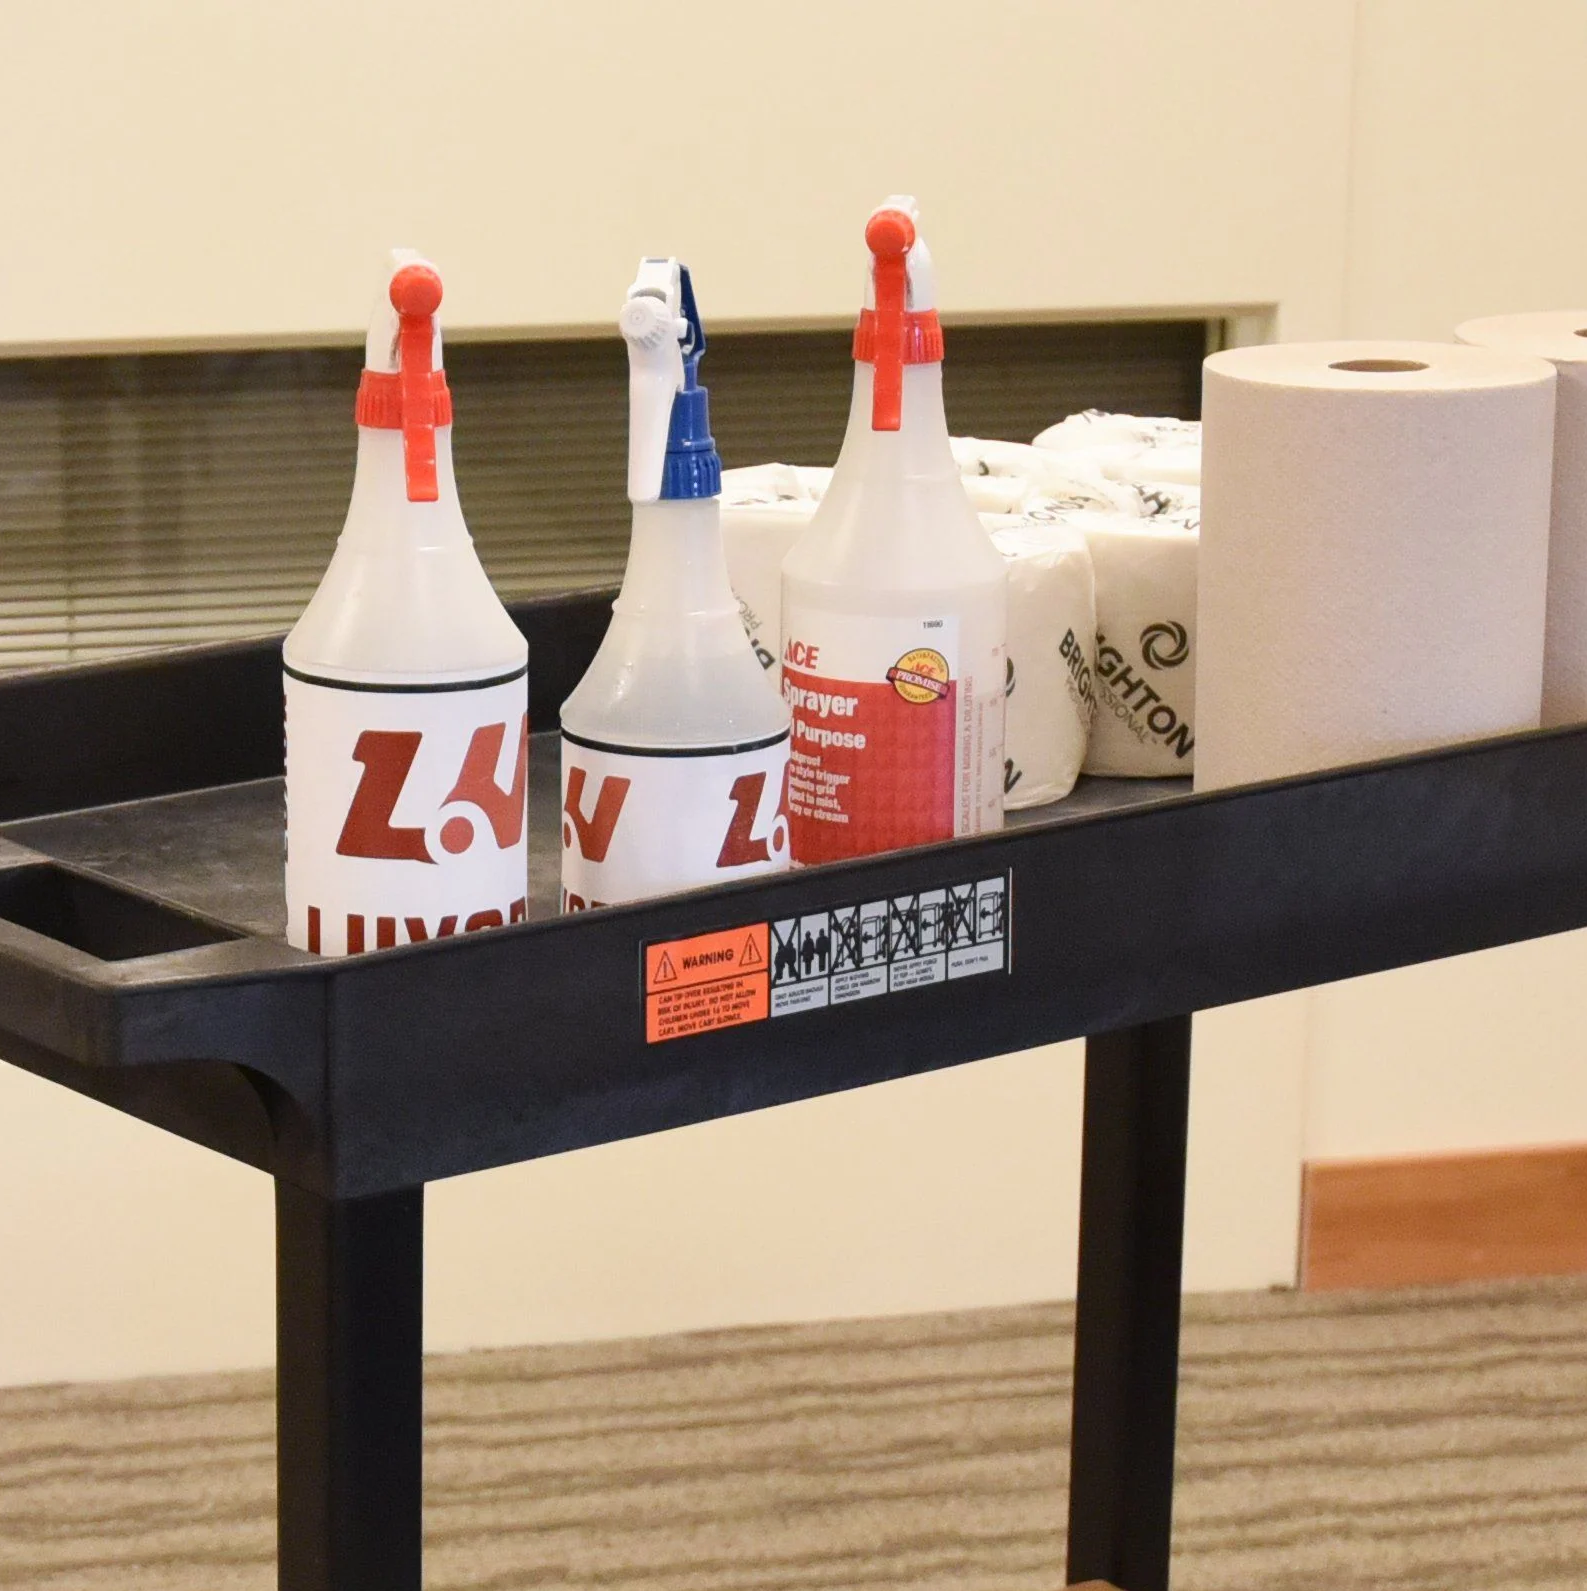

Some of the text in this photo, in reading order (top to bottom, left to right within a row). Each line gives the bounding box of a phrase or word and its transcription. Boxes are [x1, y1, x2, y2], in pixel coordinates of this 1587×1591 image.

[784, 636, 819, 669] ACE
[897, 669, 941, 692] PROMISE
[784, 677, 858, 718] Sprayer
[1096, 635, 1194, 758] GHTON
[797, 718, 866, 749] Purpose
[816, 769, 850, 785] trigger
[682, 949, 734, 969] WARNING
[736, 989, 756, 999] ALLOW
[722, 1004, 730, 1012] TO
